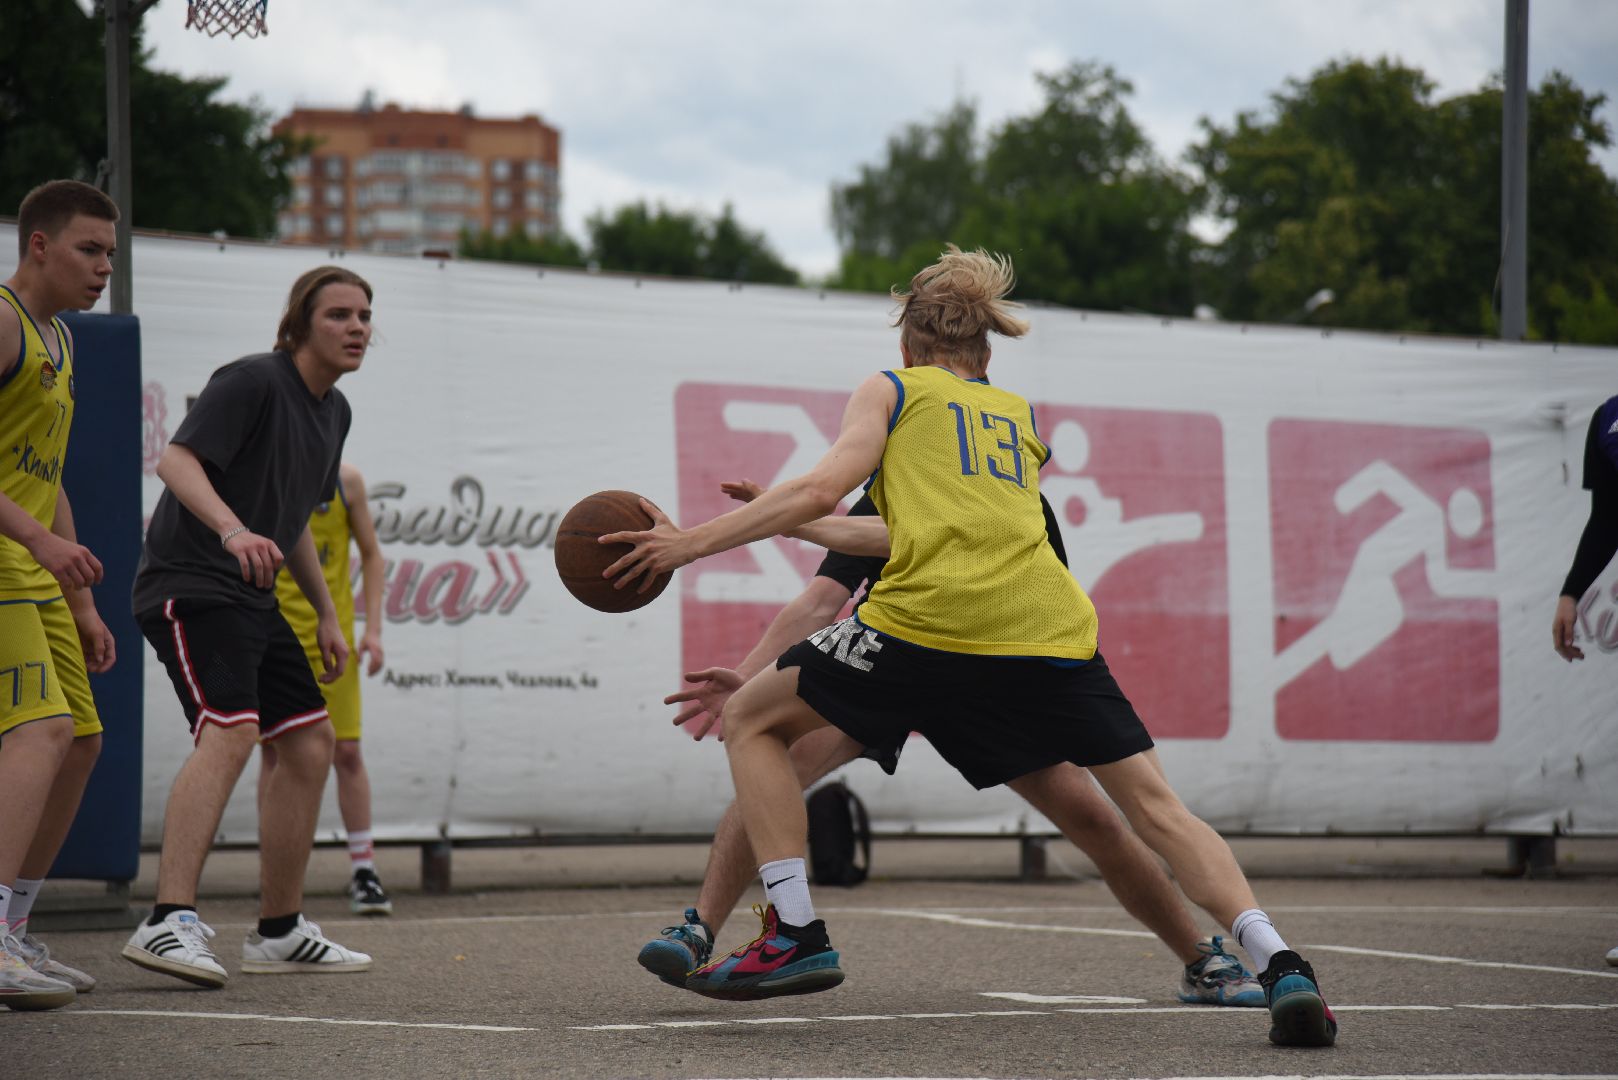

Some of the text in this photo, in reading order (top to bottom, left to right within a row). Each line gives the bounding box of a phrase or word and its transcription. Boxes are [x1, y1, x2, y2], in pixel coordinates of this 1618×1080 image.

[947, 402, 1027, 488] 13
[806, 616, 884, 673] IKE
[0, 662, 48, 707] 77
[384, 668, 441, 690] Адрес:
[445, 669, 503, 689] Химки,
